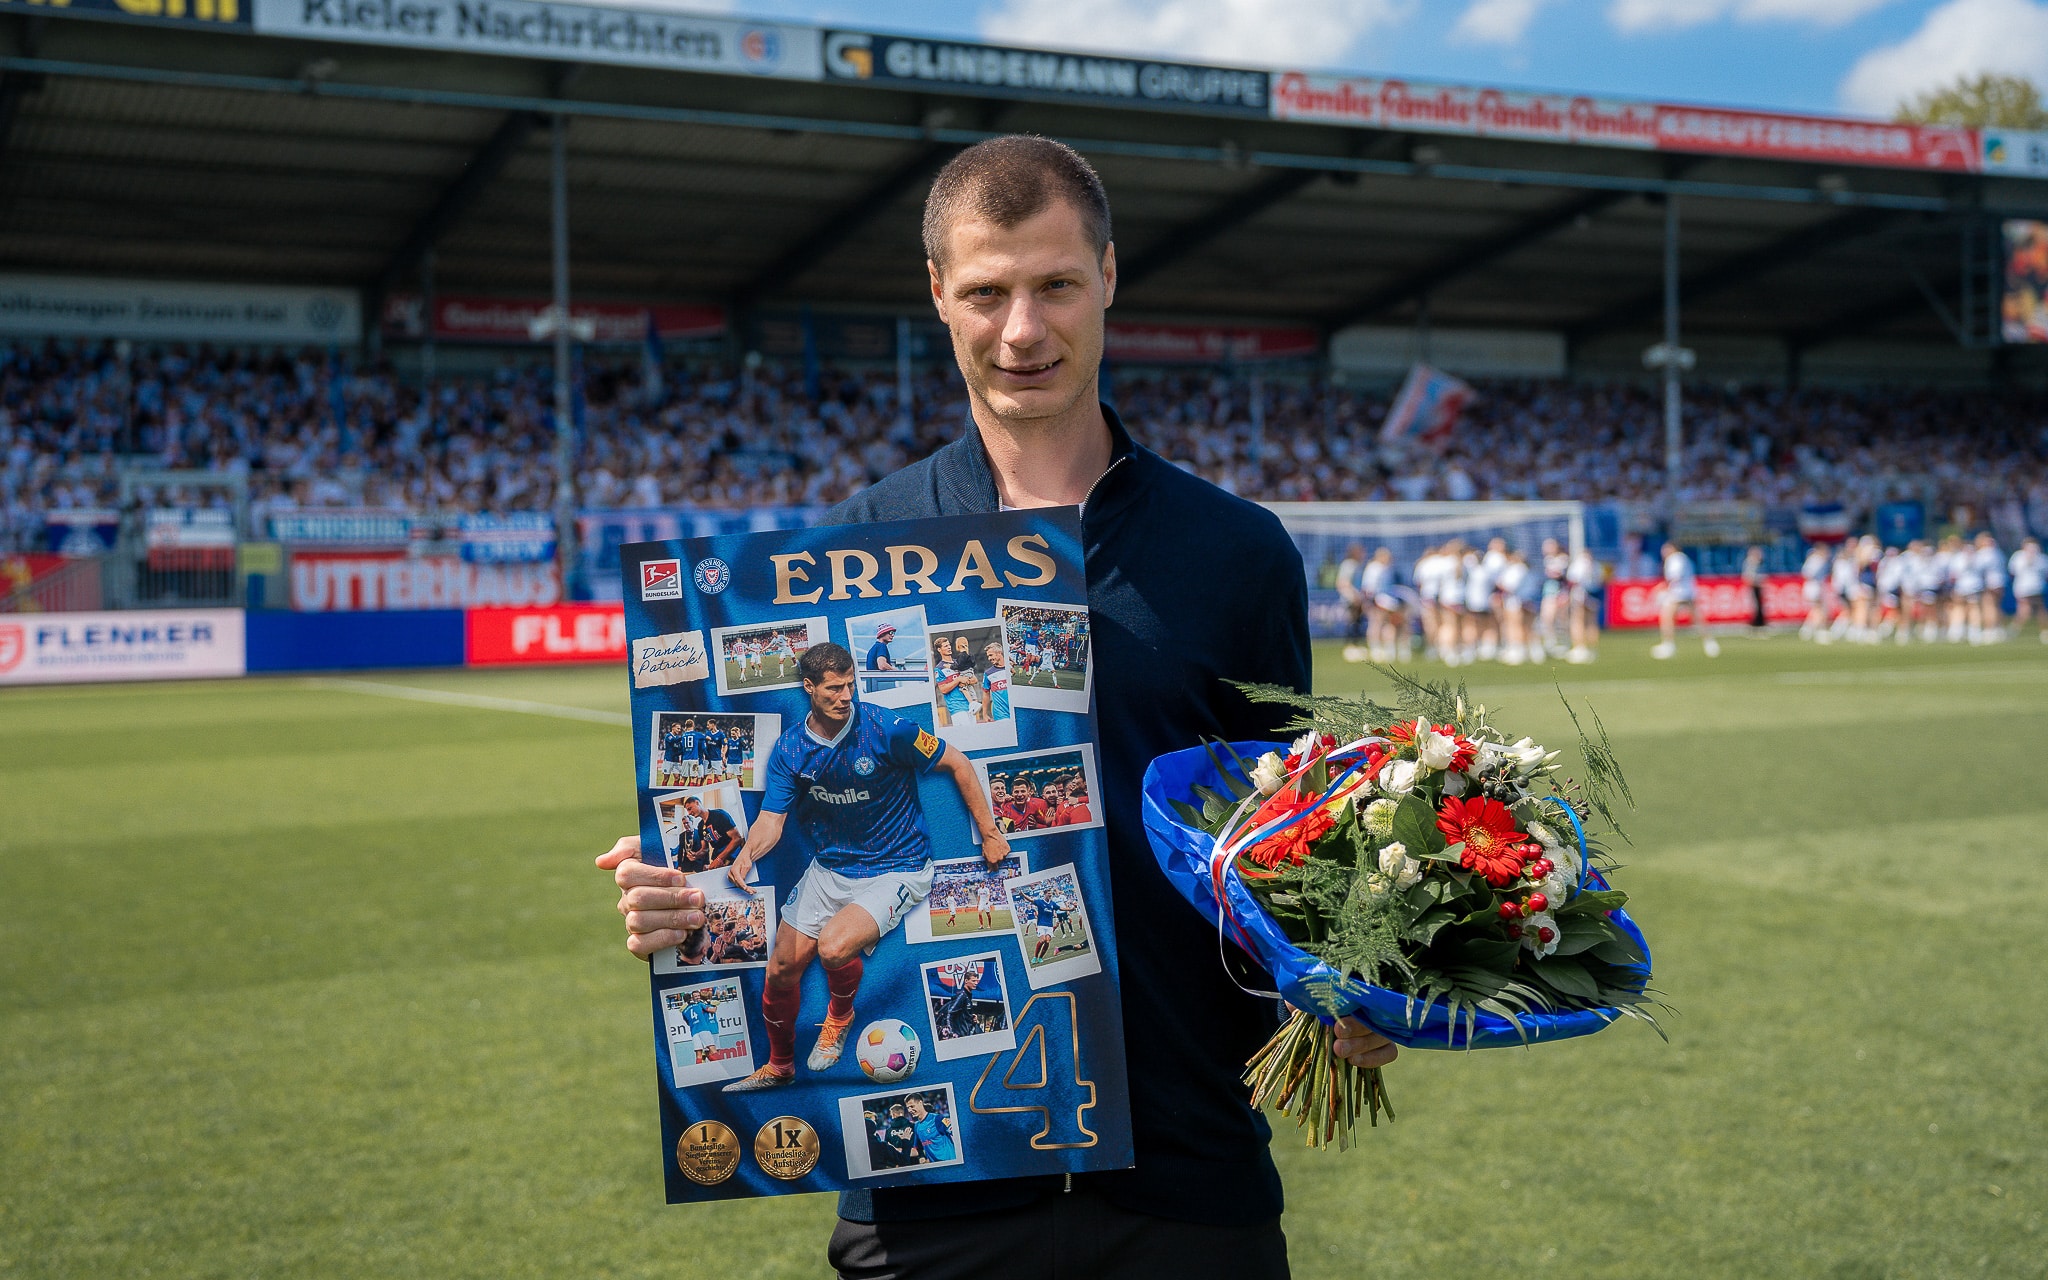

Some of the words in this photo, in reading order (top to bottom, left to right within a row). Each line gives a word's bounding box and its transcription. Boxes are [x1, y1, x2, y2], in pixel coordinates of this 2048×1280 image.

[456, 2, 722, 60] Nachrichten
[885, 41, 1137, 96] GLINDEMANN
[1139, 64, 1264, 107] GRUPPE
[770, 533, 1057, 604] ERRAS
[646, 590, 679, 598] BUNDESLIGA
[37, 622, 211, 646] FLENKER
[643, 639, 694, 660] Danke,
[638, 651, 704, 676] Patrick!
[683, 735, 694, 748] 18
[809, 786, 871, 805] famila
[719, 1016, 742, 1028] tru
[970, 992, 1099, 1150] 4
[700, 1125, 717, 1143] 1.
[773, 1121, 802, 1149] 1x
